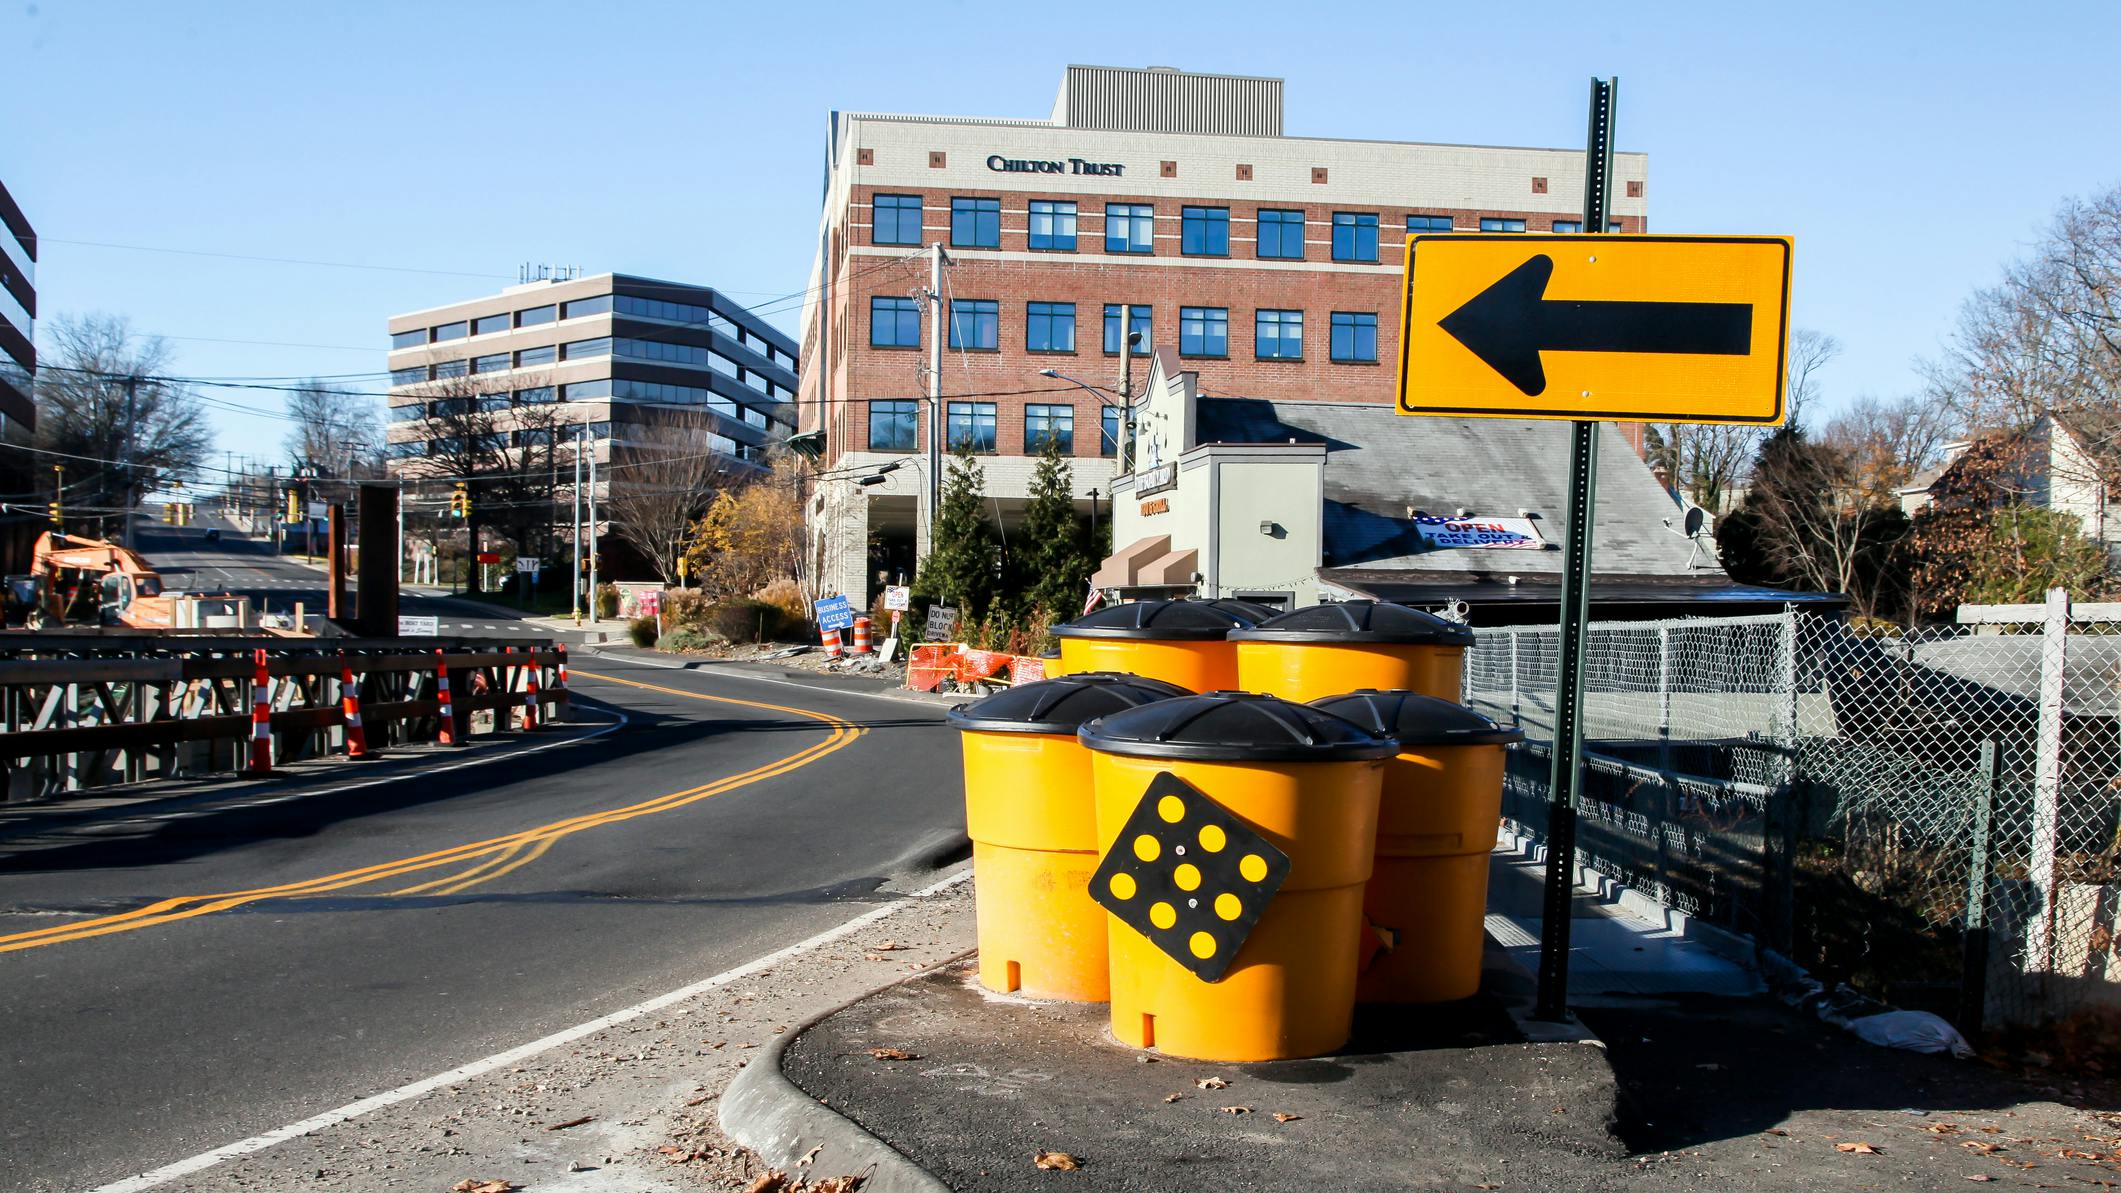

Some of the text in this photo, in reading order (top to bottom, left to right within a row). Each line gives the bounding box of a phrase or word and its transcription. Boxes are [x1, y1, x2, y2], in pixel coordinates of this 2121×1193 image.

[986, 155, 1126, 177] CHILTON TRUST
[1444, 523, 1506, 533] OPEN
[817, 601, 847, 613] BUSINESS
[822, 611, 849, 624] ACCESS
[930, 610, 940, 619] DO
